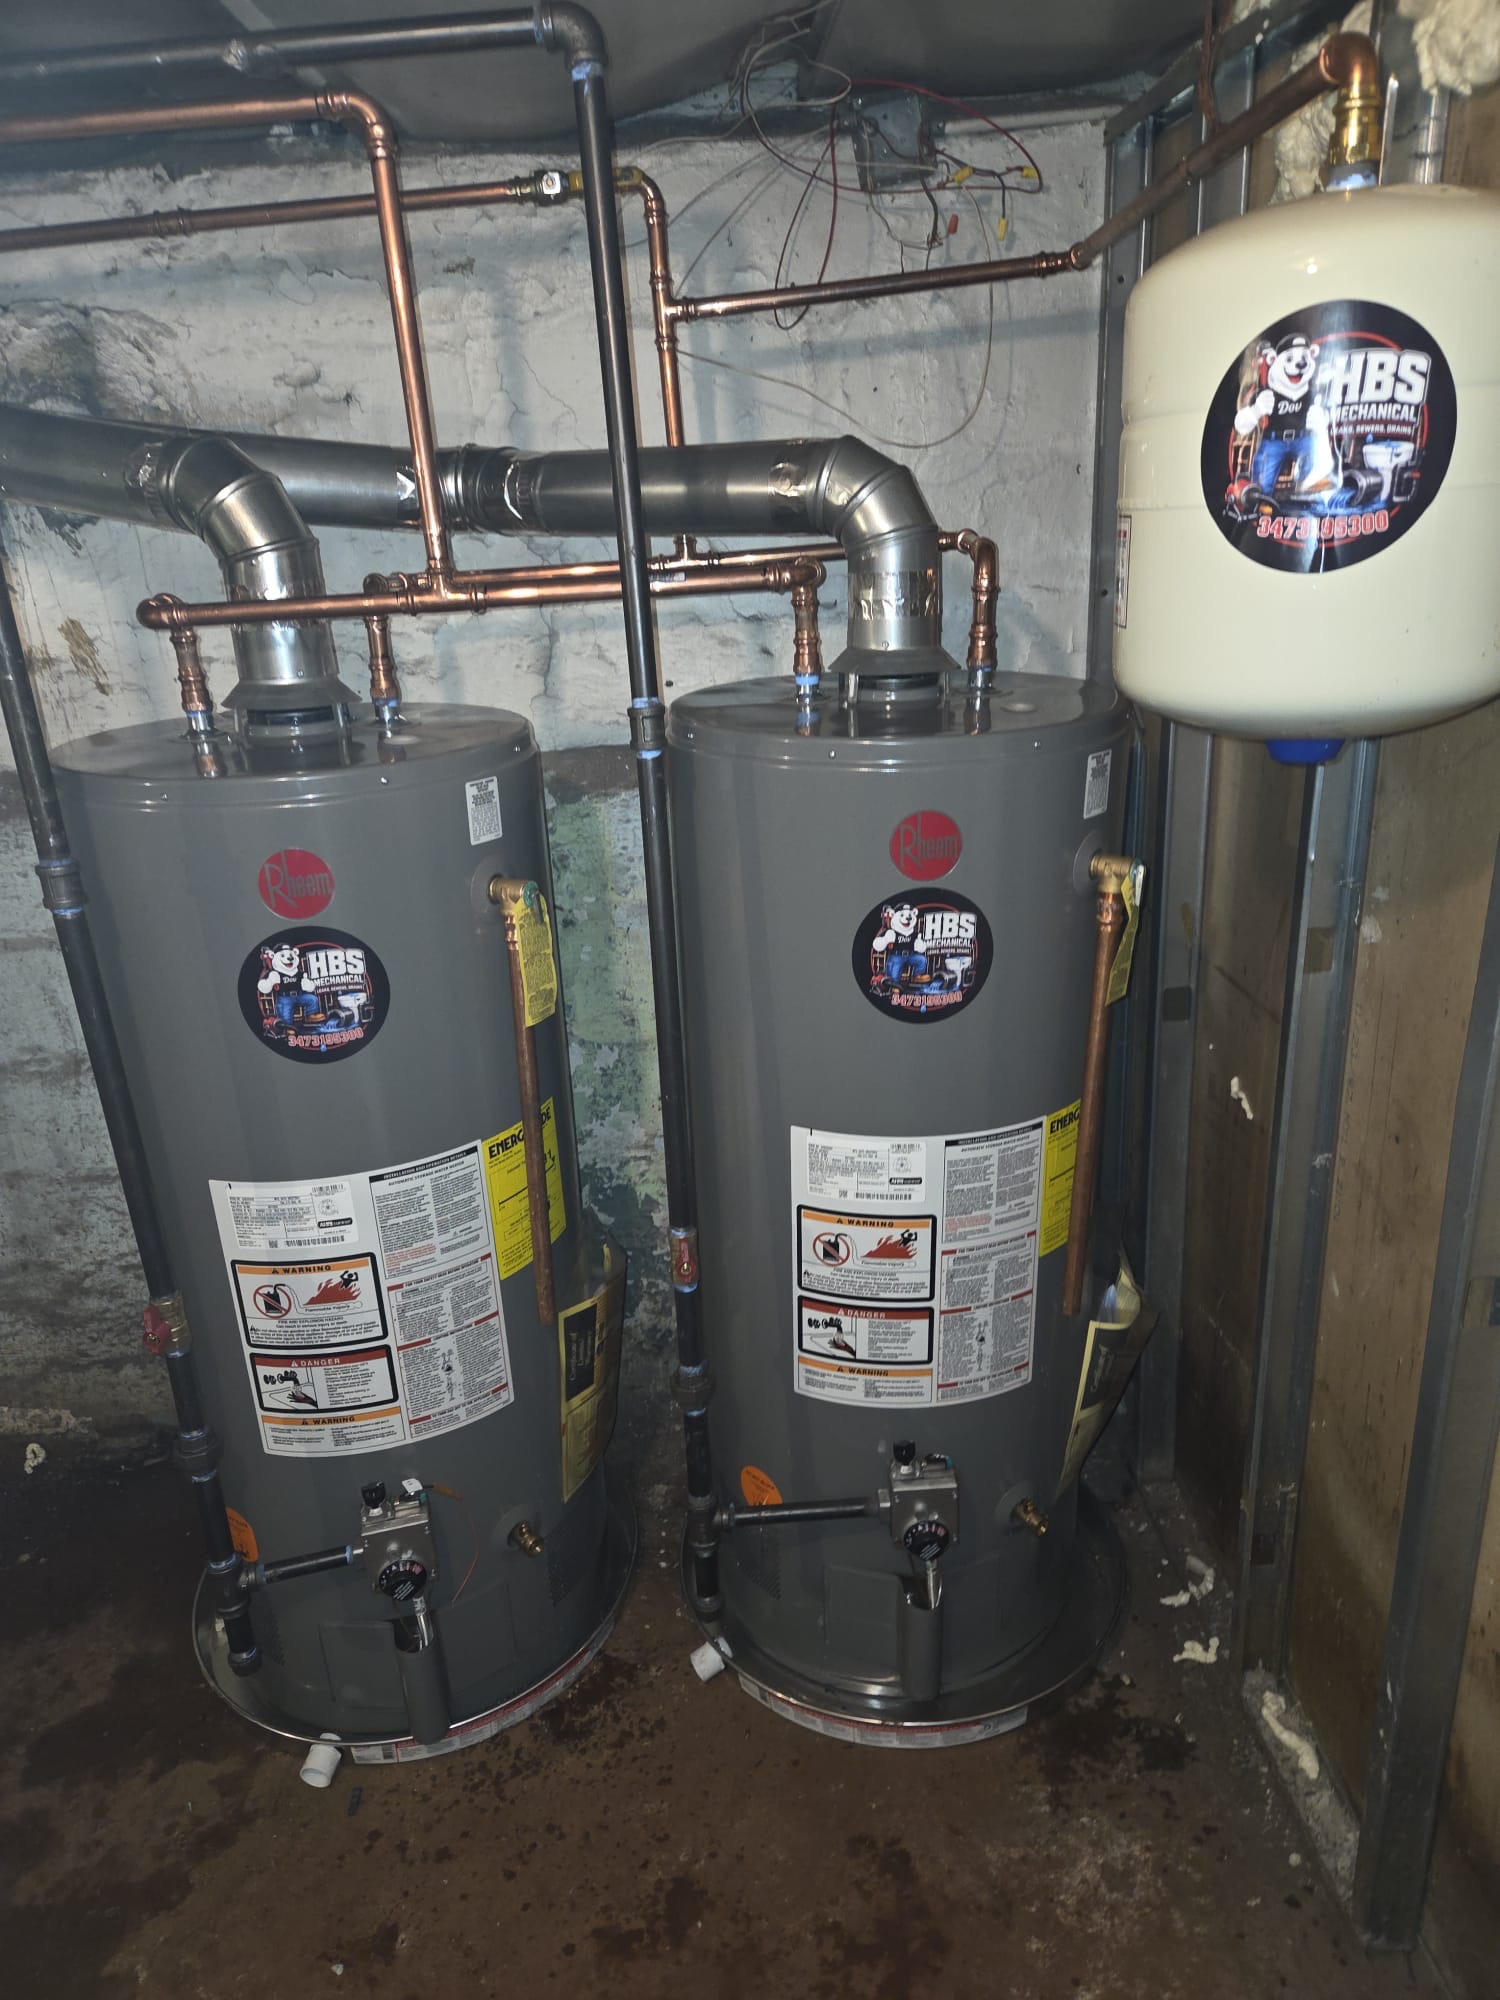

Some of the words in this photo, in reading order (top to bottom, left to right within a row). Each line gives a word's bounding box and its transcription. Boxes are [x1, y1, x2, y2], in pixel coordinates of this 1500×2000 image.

[1331, 350, 1430, 404] HBS
[1277, 400, 1302, 415] Dov
[898, 811, 959, 870] Rheem
[263, 849, 332, 909] Rheem
[925, 912, 976, 940] HBS
[926, 938, 972, 949] MECHANICAL
[308, 949, 365, 979] HBS
[314, 974, 364, 986] MECHANICAL
[1050, 1106, 1080, 1134] ENERG
[847, 1218, 894, 1228] WARNING
[283, 1265, 332, 1275] WARNING
[847, 1309, 886, 1319] DANGER
[300, 1358, 340, 1367] DANGER
[848, 1367, 889, 1376] WARNING
[312, 1416, 356, 1425] WARNING
